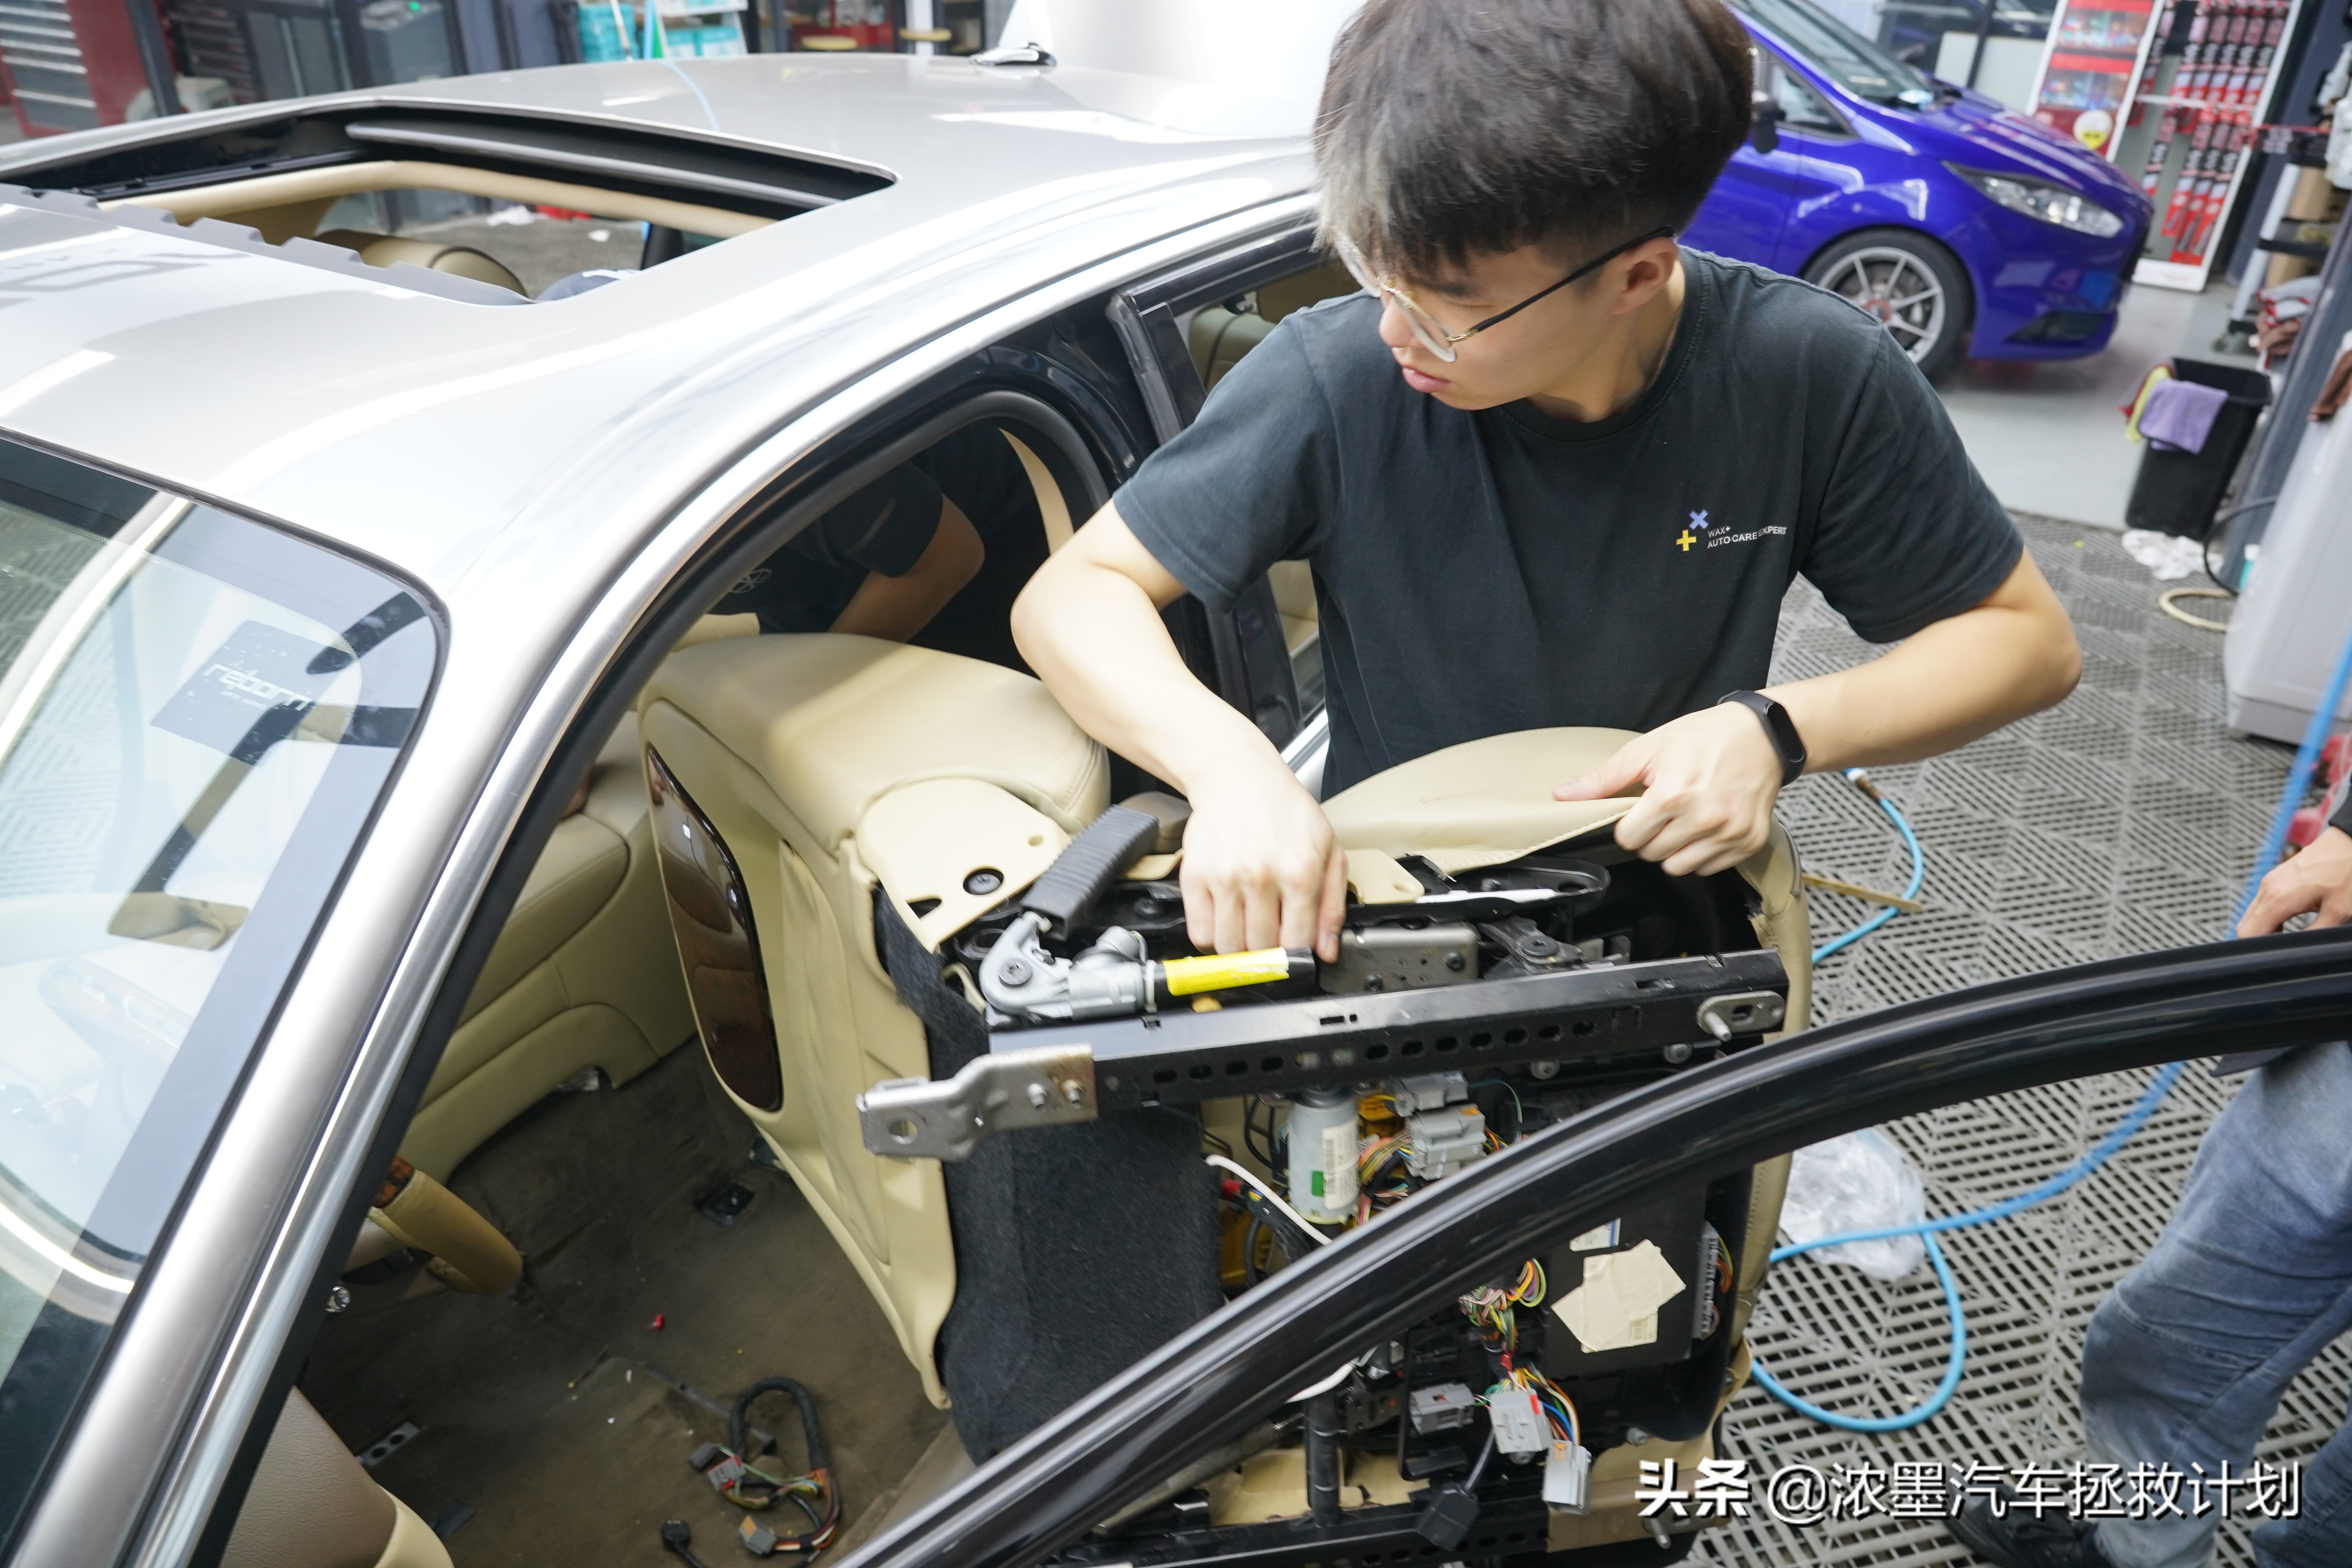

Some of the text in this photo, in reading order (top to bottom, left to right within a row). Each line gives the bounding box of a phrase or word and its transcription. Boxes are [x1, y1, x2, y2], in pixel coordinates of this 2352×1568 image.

[1707, 536, 1731, 549] AUTO
[1732, 532, 1758, 543] CARE
[202, 663, 312, 711] reborn
